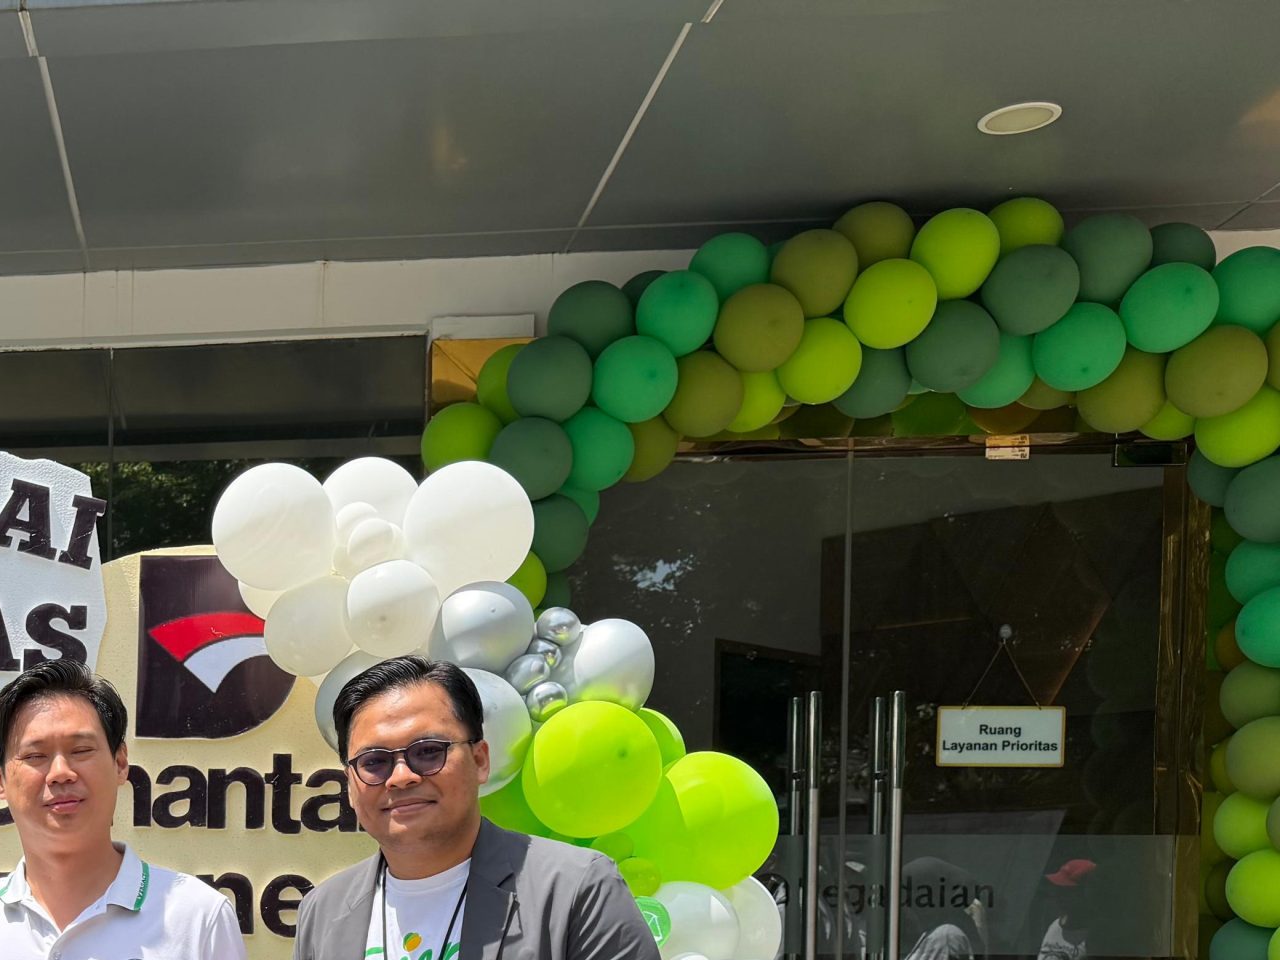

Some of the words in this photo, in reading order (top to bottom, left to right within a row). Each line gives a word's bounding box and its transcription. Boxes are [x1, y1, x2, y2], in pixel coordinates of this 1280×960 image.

[979, 724, 1022, 737] Ruang
[942, 740, 998, 753] Layanan
[1001, 740, 1058, 751] Prioritas
